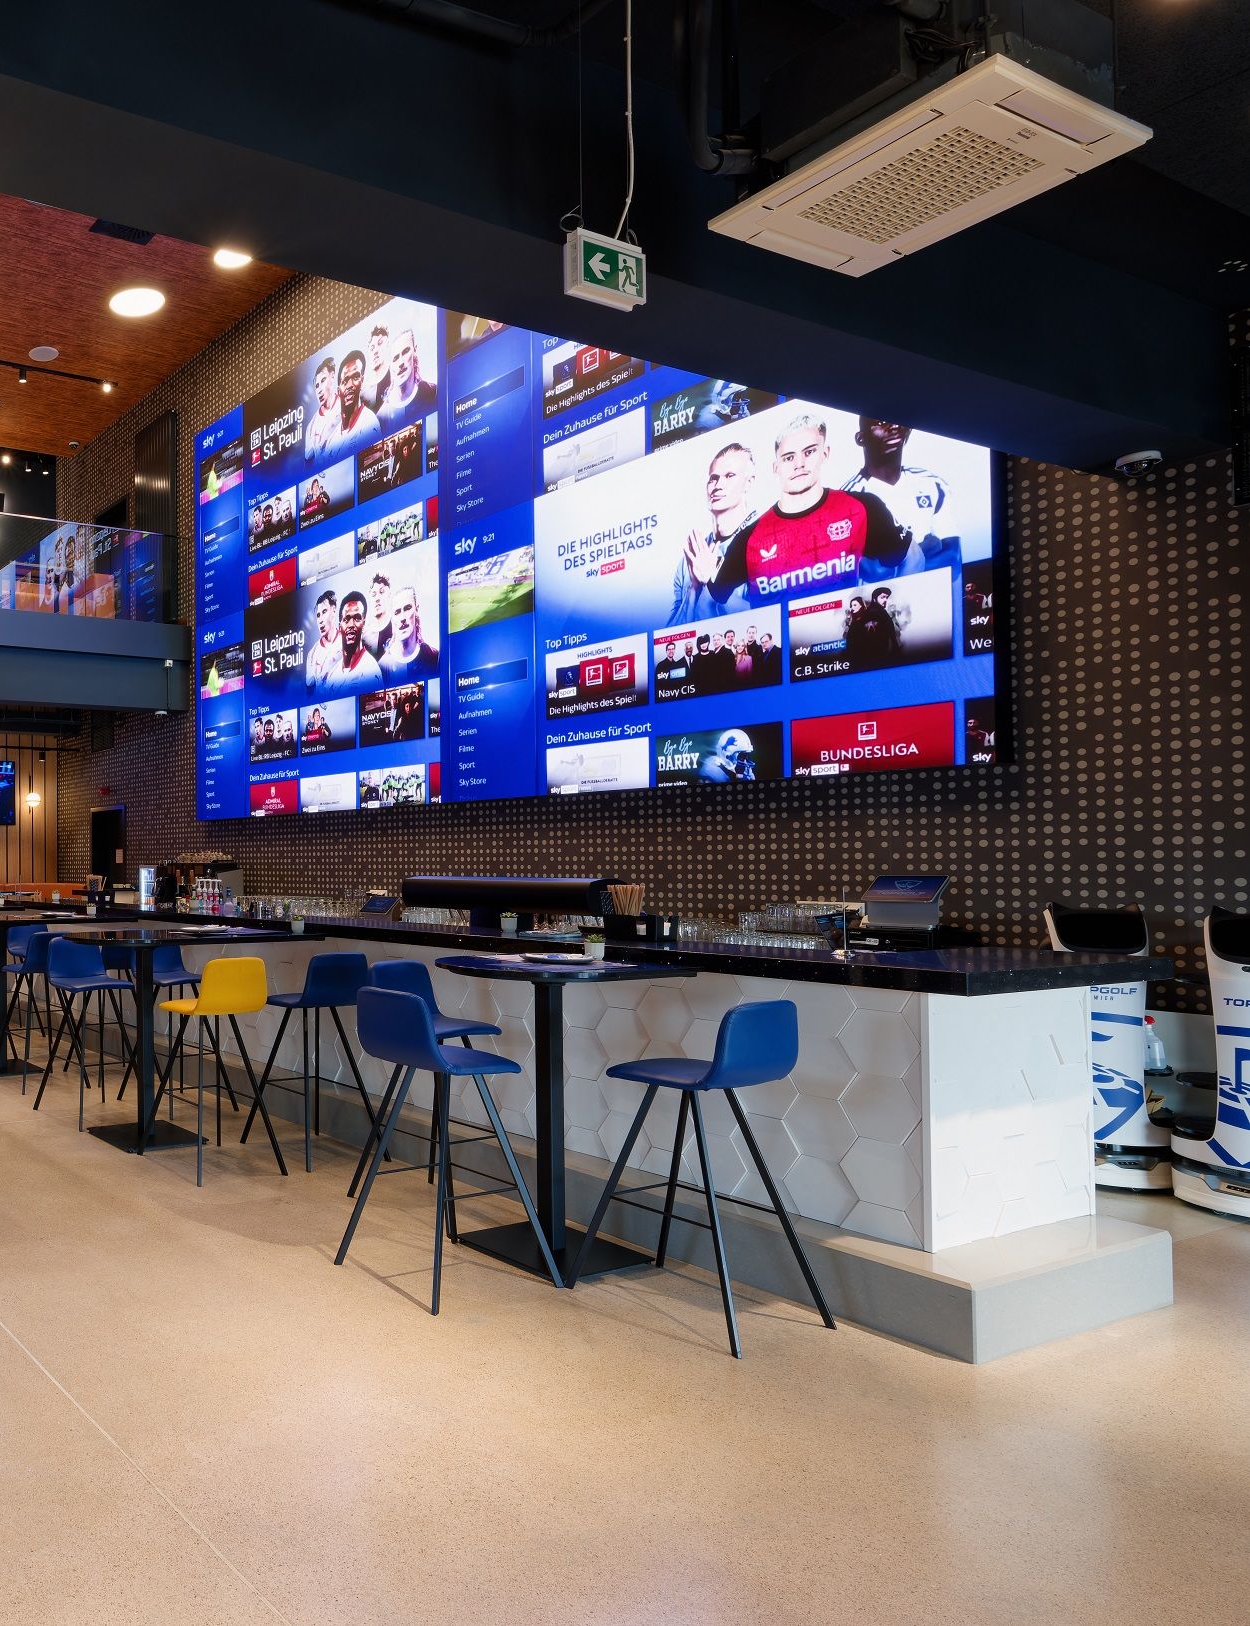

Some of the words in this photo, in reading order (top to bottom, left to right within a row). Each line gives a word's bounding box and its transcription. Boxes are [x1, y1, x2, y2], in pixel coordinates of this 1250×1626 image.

[542, 337, 558, 349] Top
[545, 388, 555, 398] sky
[556, 381, 572, 394] sport
[546, 404, 558, 414] Die
[559, 387, 595, 408] Highlights
[596, 380, 610, 391] des
[456, 398, 478, 414] Home
[264, 406, 304, 440] Leipzing
[456, 421, 464, 430] TV
[465, 412, 482, 426] Guide
[544, 430, 562, 444] Dein
[564, 414, 602, 435] Zuhause
[604, 406, 618, 418] für
[620, 392, 648, 411] Sport
[654, 406, 696, 437] BARRY
[203, 433, 215, 449] sky
[264, 442, 277, 460] St.
[279, 423, 303, 452] Pauli
[456, 426, 490, 446] Aufnahmen
[456, 450, 474, 463] Serien
[456, 468, 472, 480] Filme
[456, 484, 472, 496] Sport
[548, 484, 558, 492] sky
[456, 502, 466, 512] Sky
[467, 496, 484, 508] Store
[455, 536, 476, 555] sky
[482, 532, 494, 543] 9:21
[558, 540, 576, 557] DIE
[580, 514, 658, 550] HIGHLIGHTS
[248, 563, 258, 572] Dein
[258, 555, 277, 568] Zuhause
[284, 546, 298, 557] Sport
[564, 554, 586, 570] DES
[590, 533, 652, 562] SPIELTAGS
[586, 568, 599, 578] sky
[601, 560, 624, 576] sport
[756, 551, 856, 595] Barmenia
[796, 606, 810, 615] NEUE
[812, 602, 835, 612] FOLGEN
[970, 616, 990, 626] sky
[204, 632, 216, 644] sky
[265, 630, 304, 654] Leipzing
[546, 640, 562, 649] Top
[563, 633, 588, 646] Tipps
[970, 638, 992, 650] We
[577, 646, 612, 658] HIGHLIGHTS
[795, 646, 810, 656] sky
[812, 640, 846, 652] atlantic
[264, 657, 278, 674] St.
[280, 648, 304, 670] Pauli
[795, 665, 814, 677] C.B.
[817, 660, 850, 674] Strike
[458, 676, 480, 686] Home
[657, 672, 669, 680] sky
[467, 692, 484, 702] Guide
[560, 688, 576, 698] sport
[658, 689, 680, 698] Navy
[681, 684, 696, 694] CIS
[249, 708, 258, 716] Top
[258, 706, 270, 714] Tipps
[458, 708, 492, 720] Aufnahmen
[562, 702, 598, 714] Highlights
[600, 698, 614, 706] des
[206, 730, 218, 738] Home
[458, 728, 478, 736] Serien
[546, 734, 566, 744] Dein
[568, 729, 606, 742] Zuhause
[608, 726, 622, 736] für
[624, 722, 652, 736] Sport
[664, 740, 677, 755] Bye
[679, 736, 694, 752] Bye
[820, 743, 918, 762] BUNDESLIGA
[658, 752, 700, 772] BARRY
[972, 752, 992, 763] sky
[459, 762, 476, 770] Sport
[795, 766, 810, 776] sky
[812, 764, 838, 774] sport
[250, 774, 259, 782] Dein
[260, 772, 278, 780] Zuhause
[278, 770, 286, 778] für
[286, 769, 300, 778] Sport
[470, 777, 486, 785] Store
[551, 786, 560, 794] sky
